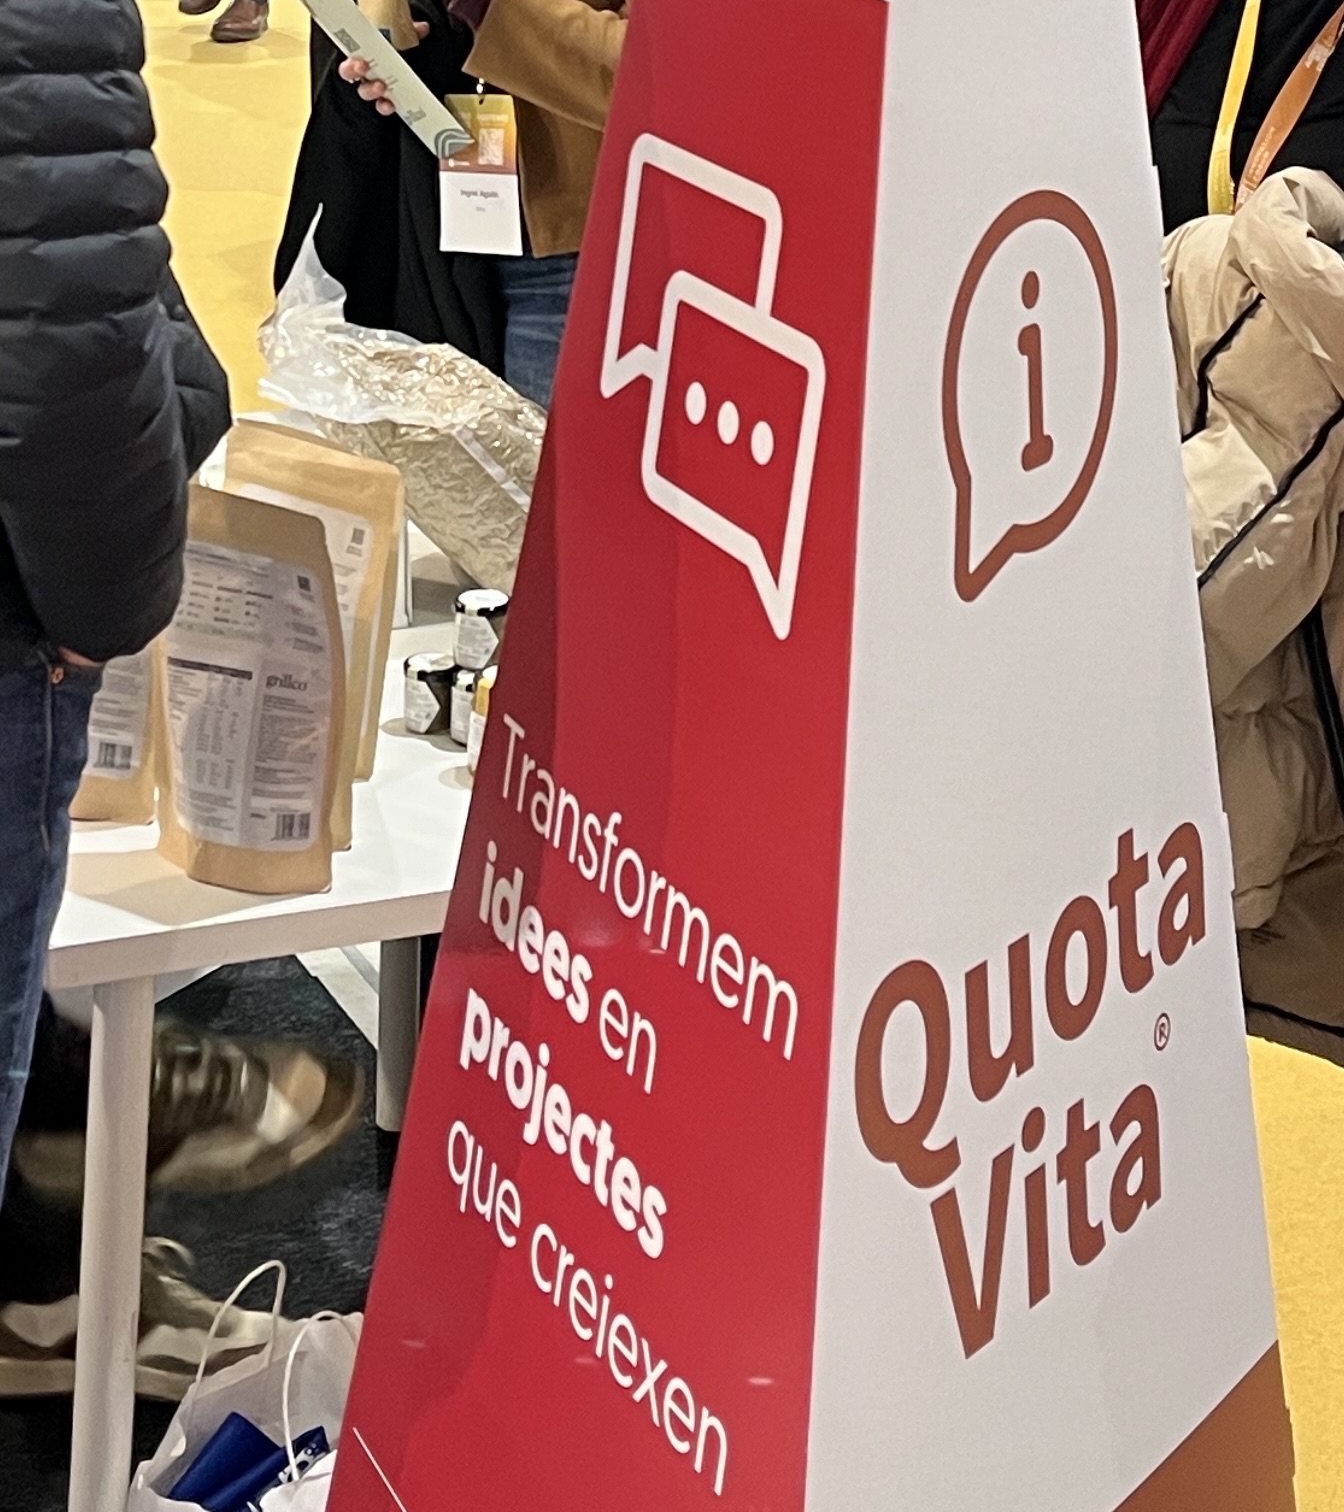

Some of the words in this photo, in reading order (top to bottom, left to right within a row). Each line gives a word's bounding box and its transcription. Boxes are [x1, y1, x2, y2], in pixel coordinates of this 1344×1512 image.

[480, 841, 593, 1024] idees
[598, 987, 657, 1094] en
[502, 714, 800, 1060] Transformem
[855, 818, 1208, 1189] Quota
[461, 988, 667, 1260] projectes
[931, 1082, 1163, 1360] Vita
[447, 1119, 521, 1249] que
[530, 1221, 729, 1495] creiexen
